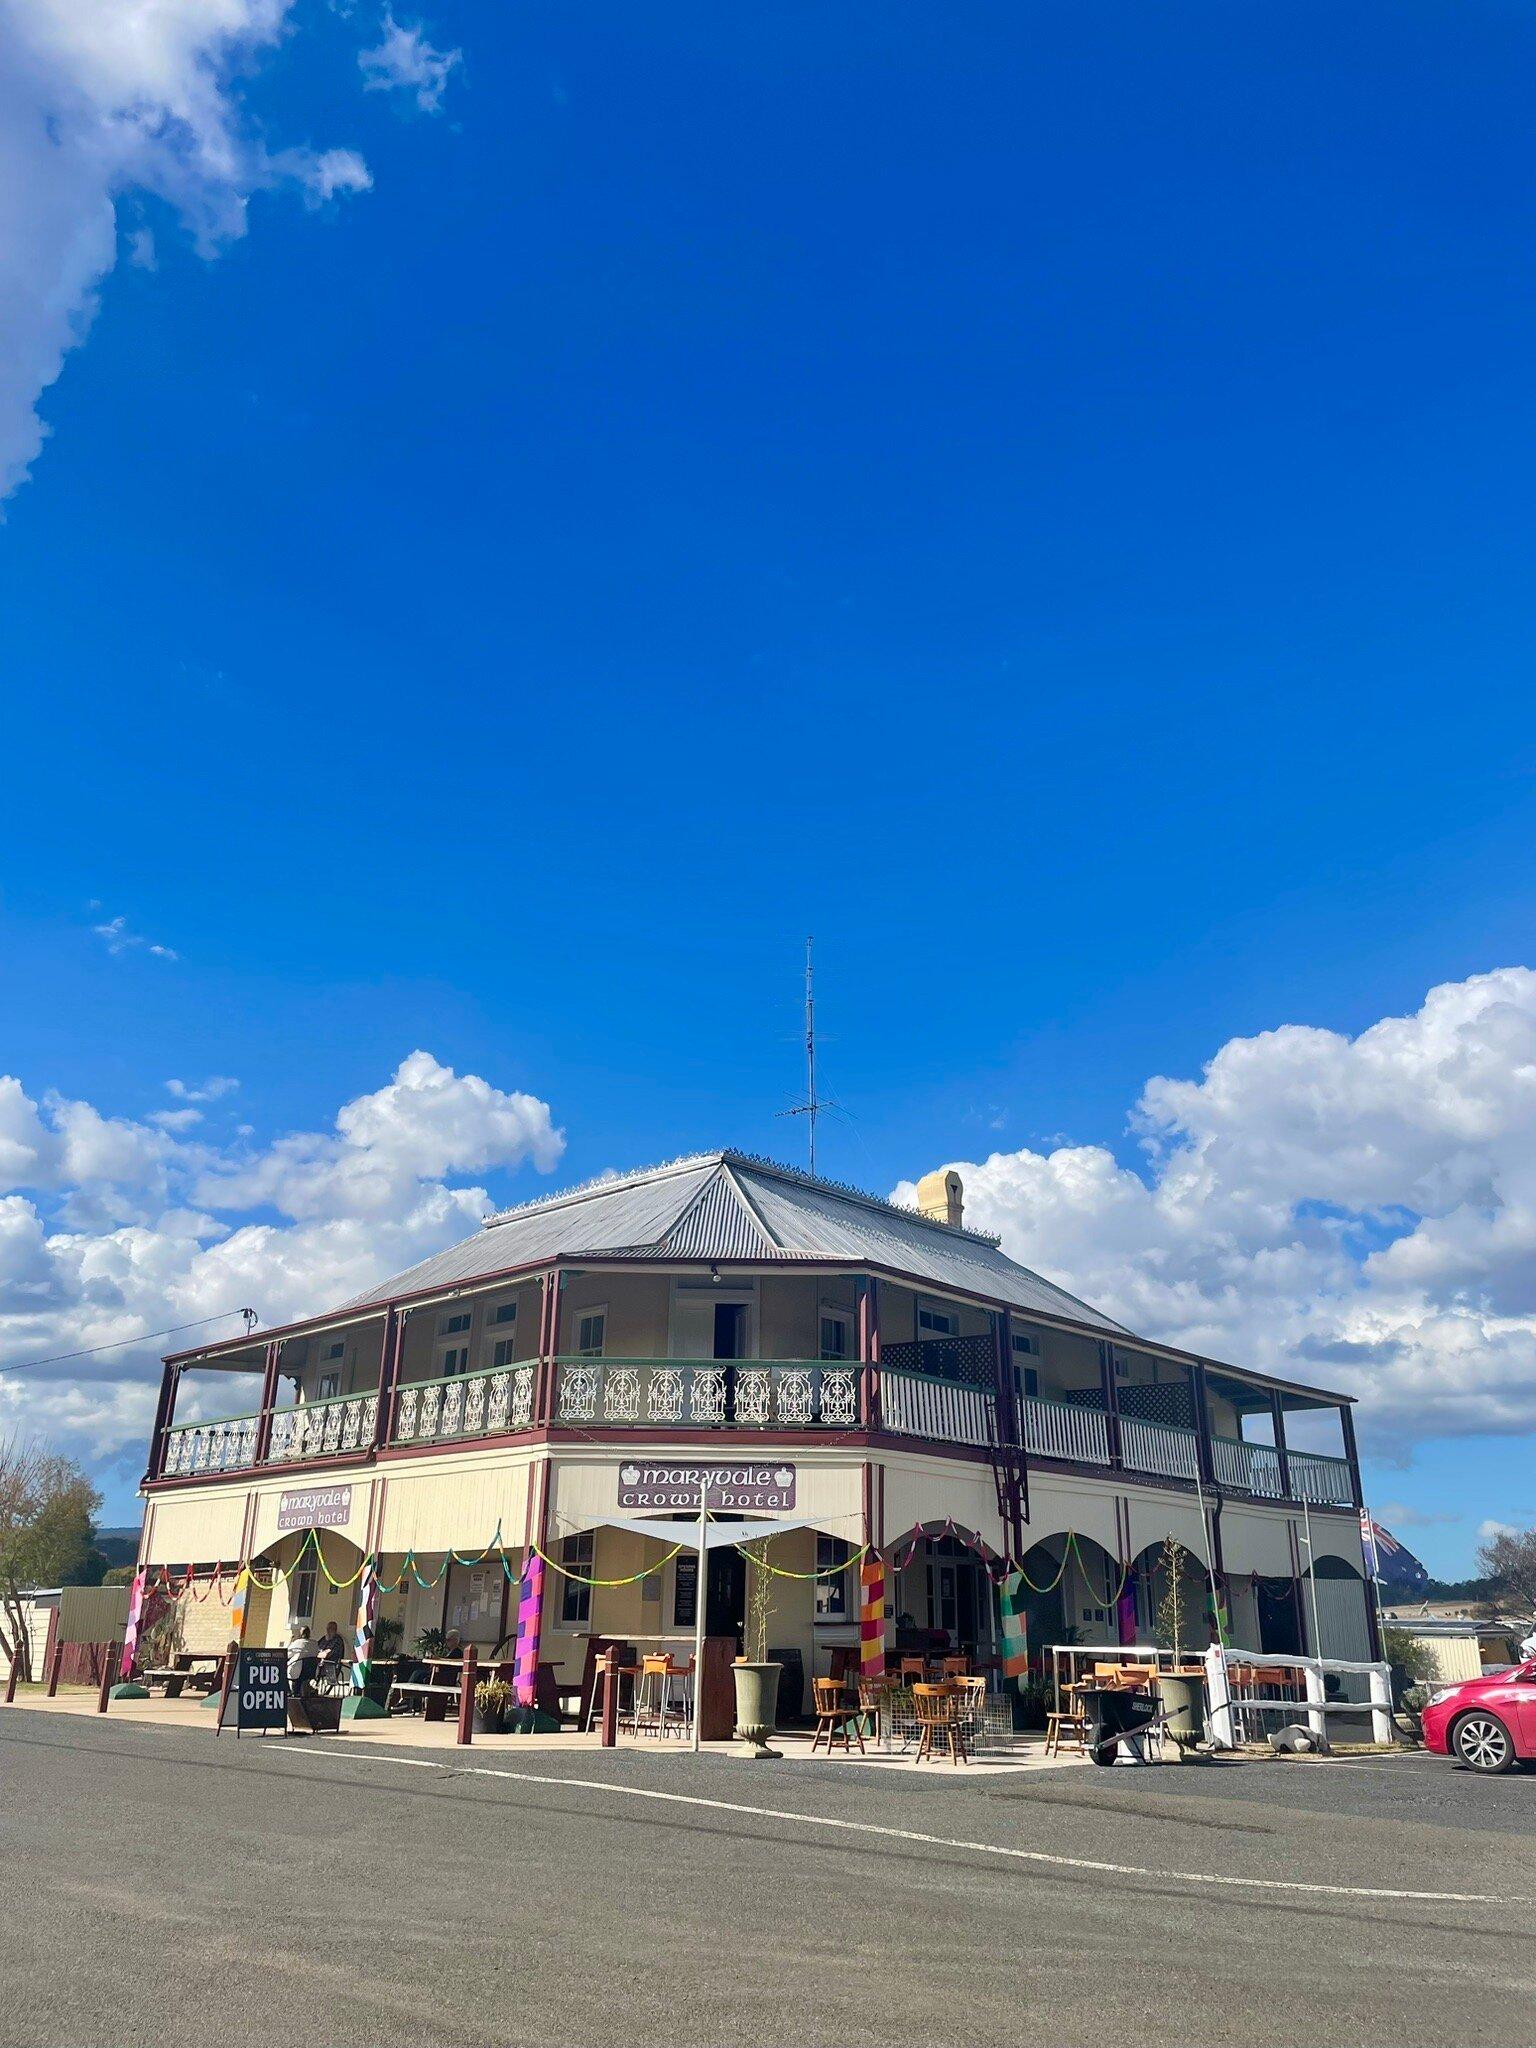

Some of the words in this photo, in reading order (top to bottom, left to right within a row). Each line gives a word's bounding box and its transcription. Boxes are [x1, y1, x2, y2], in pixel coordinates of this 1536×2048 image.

[721, 1491, 790, 1507] hotel
[317, 1509, 348, 1525] hotel
[249, 1665, 280, 1685] PUB
[242, 1690, 285, 1710] OPEN
